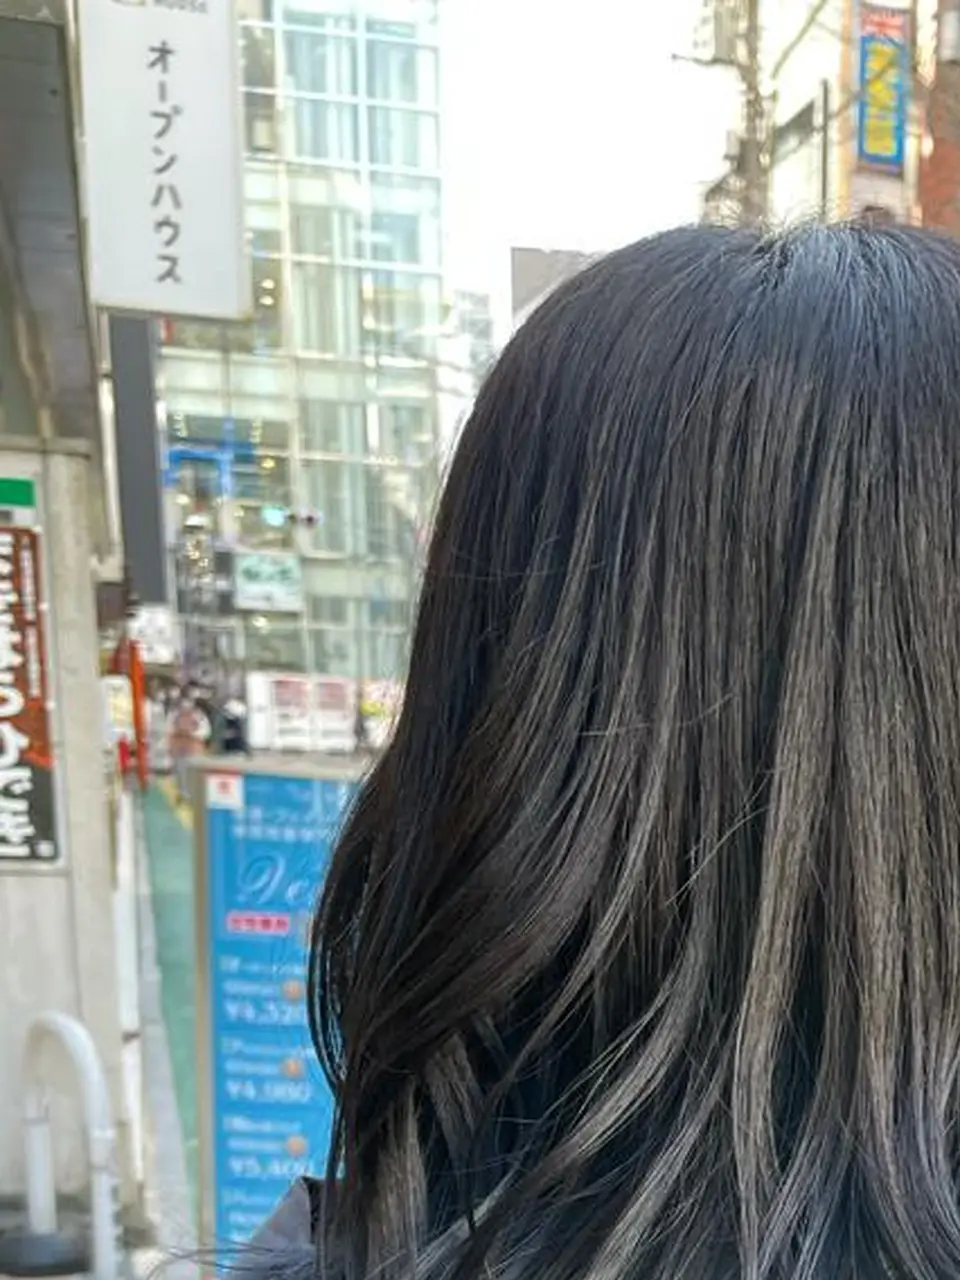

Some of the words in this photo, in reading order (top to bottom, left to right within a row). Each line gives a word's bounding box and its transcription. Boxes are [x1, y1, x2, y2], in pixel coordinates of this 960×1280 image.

[147, 40, 183, 284] オープンハウス
